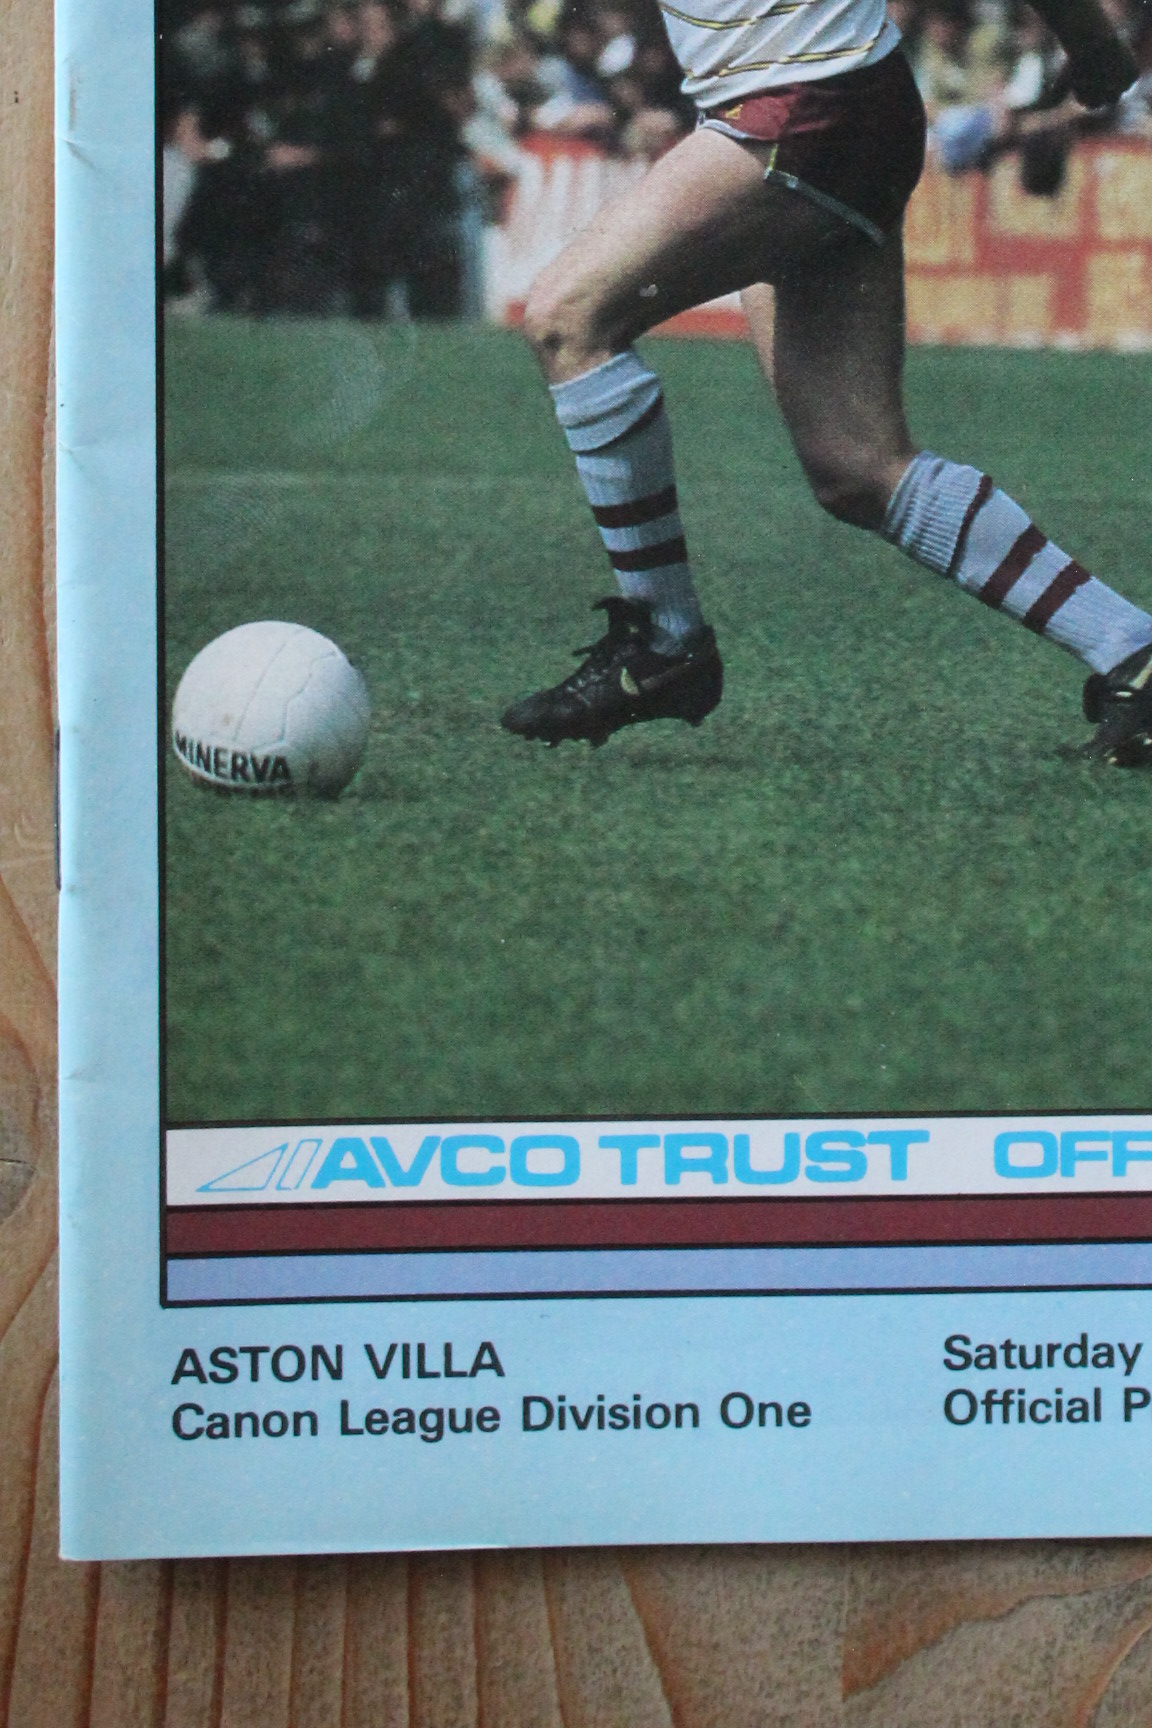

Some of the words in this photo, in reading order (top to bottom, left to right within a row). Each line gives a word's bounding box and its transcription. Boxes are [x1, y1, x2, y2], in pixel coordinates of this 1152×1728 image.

[174, 729, 292, 784] MINERVA
[311, 1134, 581, 1189] AVCO
[598, 1129, 930, 1186] TRUST
[170, 1344, 343, 1385] ASTON
[363, 1341, 505, 1380] VILLA
[943, 1333, 1142, 1375] Saturday
[172, 1402, 318, 1441] Canon
[340, 1399, 500, 1444] League
[522, 1394, 700, 1432] Division
[720, 1392, 811, 1429] One
[943, 1386, 1102, 1426] Official
